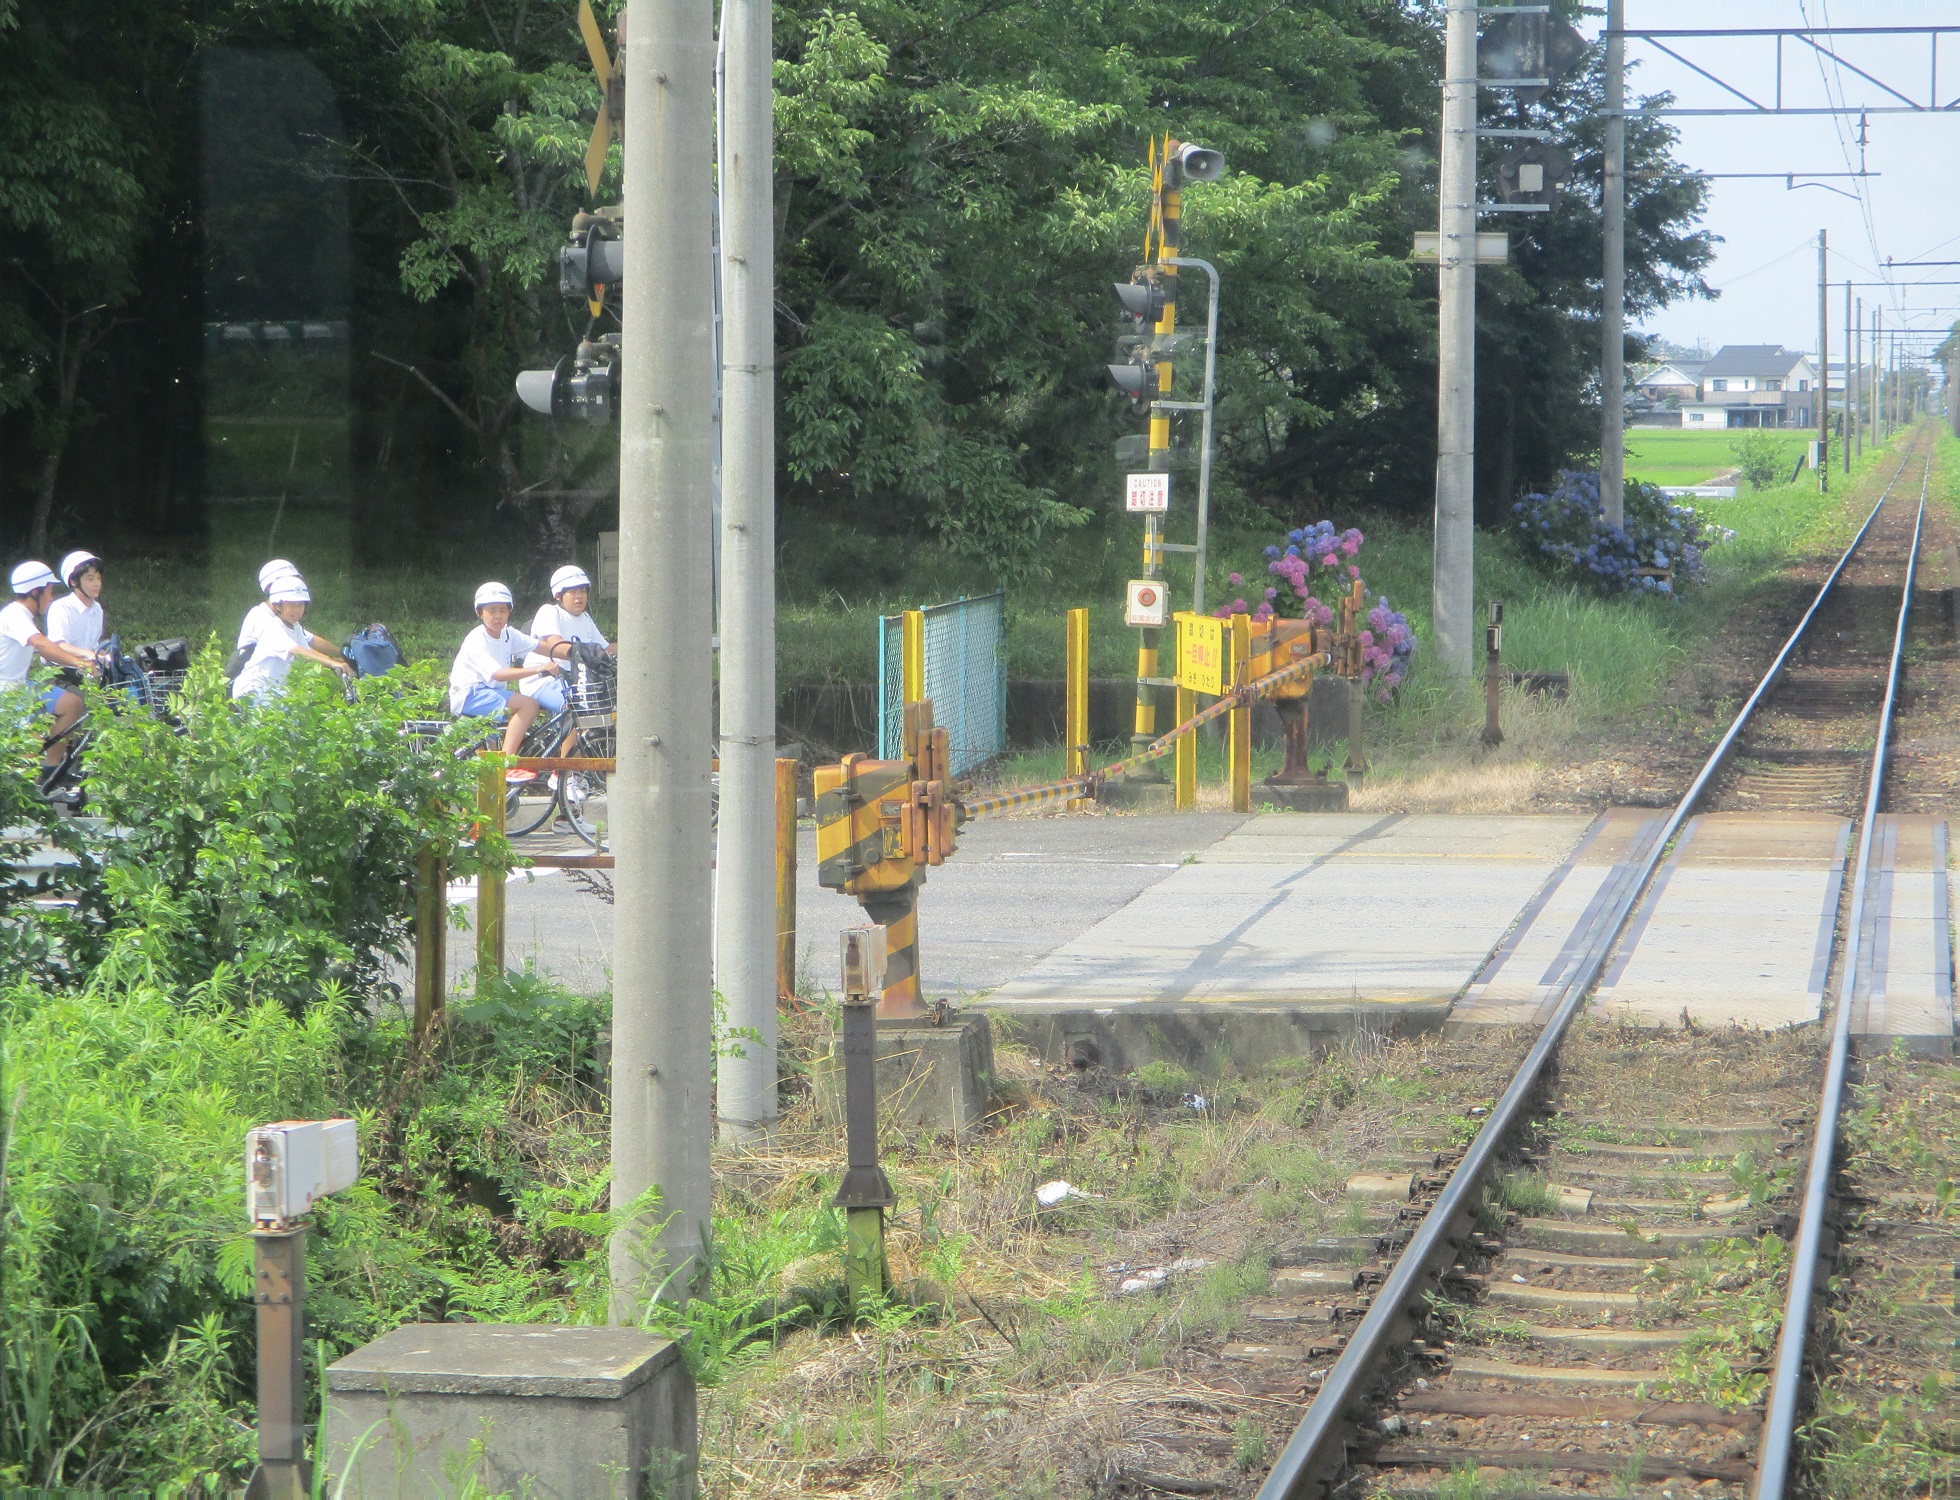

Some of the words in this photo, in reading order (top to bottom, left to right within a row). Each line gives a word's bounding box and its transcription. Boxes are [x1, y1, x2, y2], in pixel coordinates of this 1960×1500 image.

[1133, 479, 1162, 488] CAUTION
[1131, 490, 1163, 507] 踏切注意
